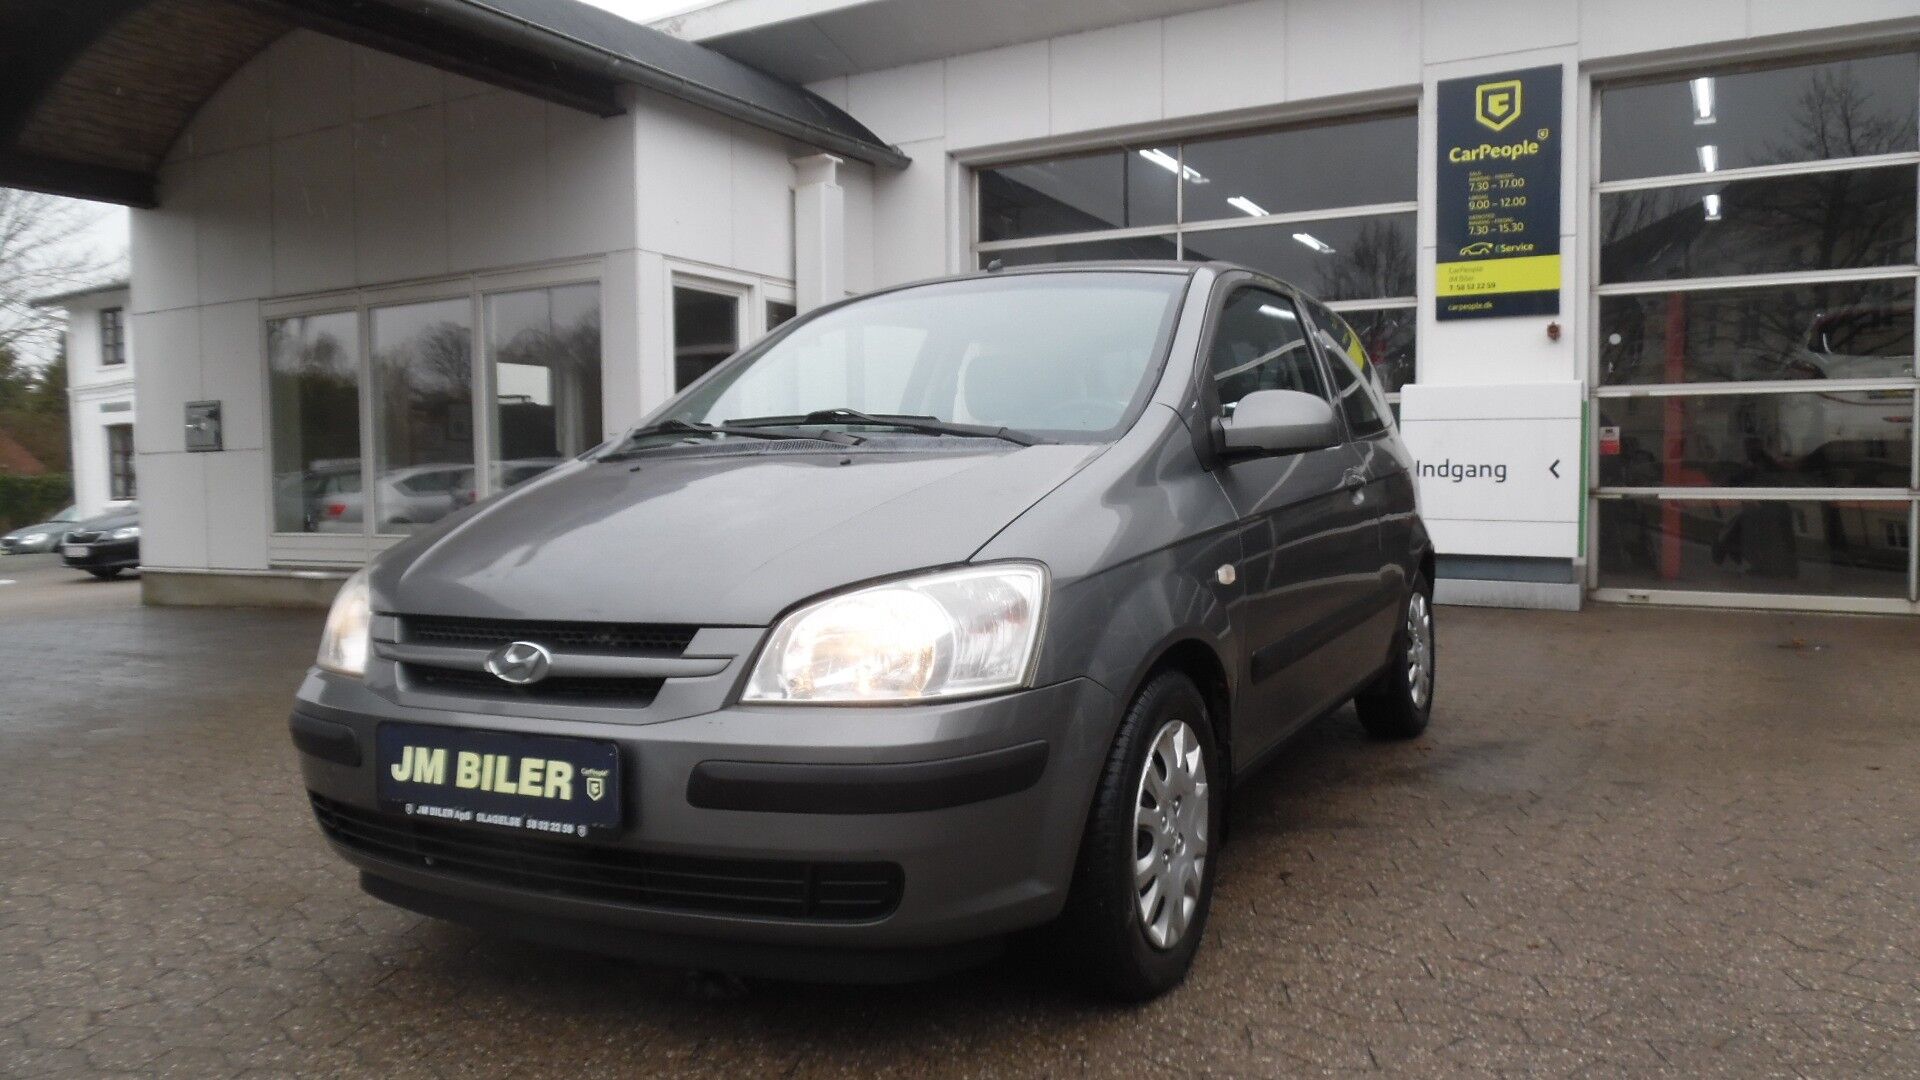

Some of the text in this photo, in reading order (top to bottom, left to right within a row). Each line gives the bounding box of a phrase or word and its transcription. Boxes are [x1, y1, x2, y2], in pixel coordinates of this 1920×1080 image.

[1449, 139, 1539, 163] CarPeople
[1500, 178, 1525, 189] 17.00
[1468, 200, 1490, 210] 9.00
[1501, 197, 1527, 207] 12.00
[1500, 222, 1524, 233] 15.30
[1416, 459, 1507, 483] Indgang
[390, 746, 574, 801] JM BILER
